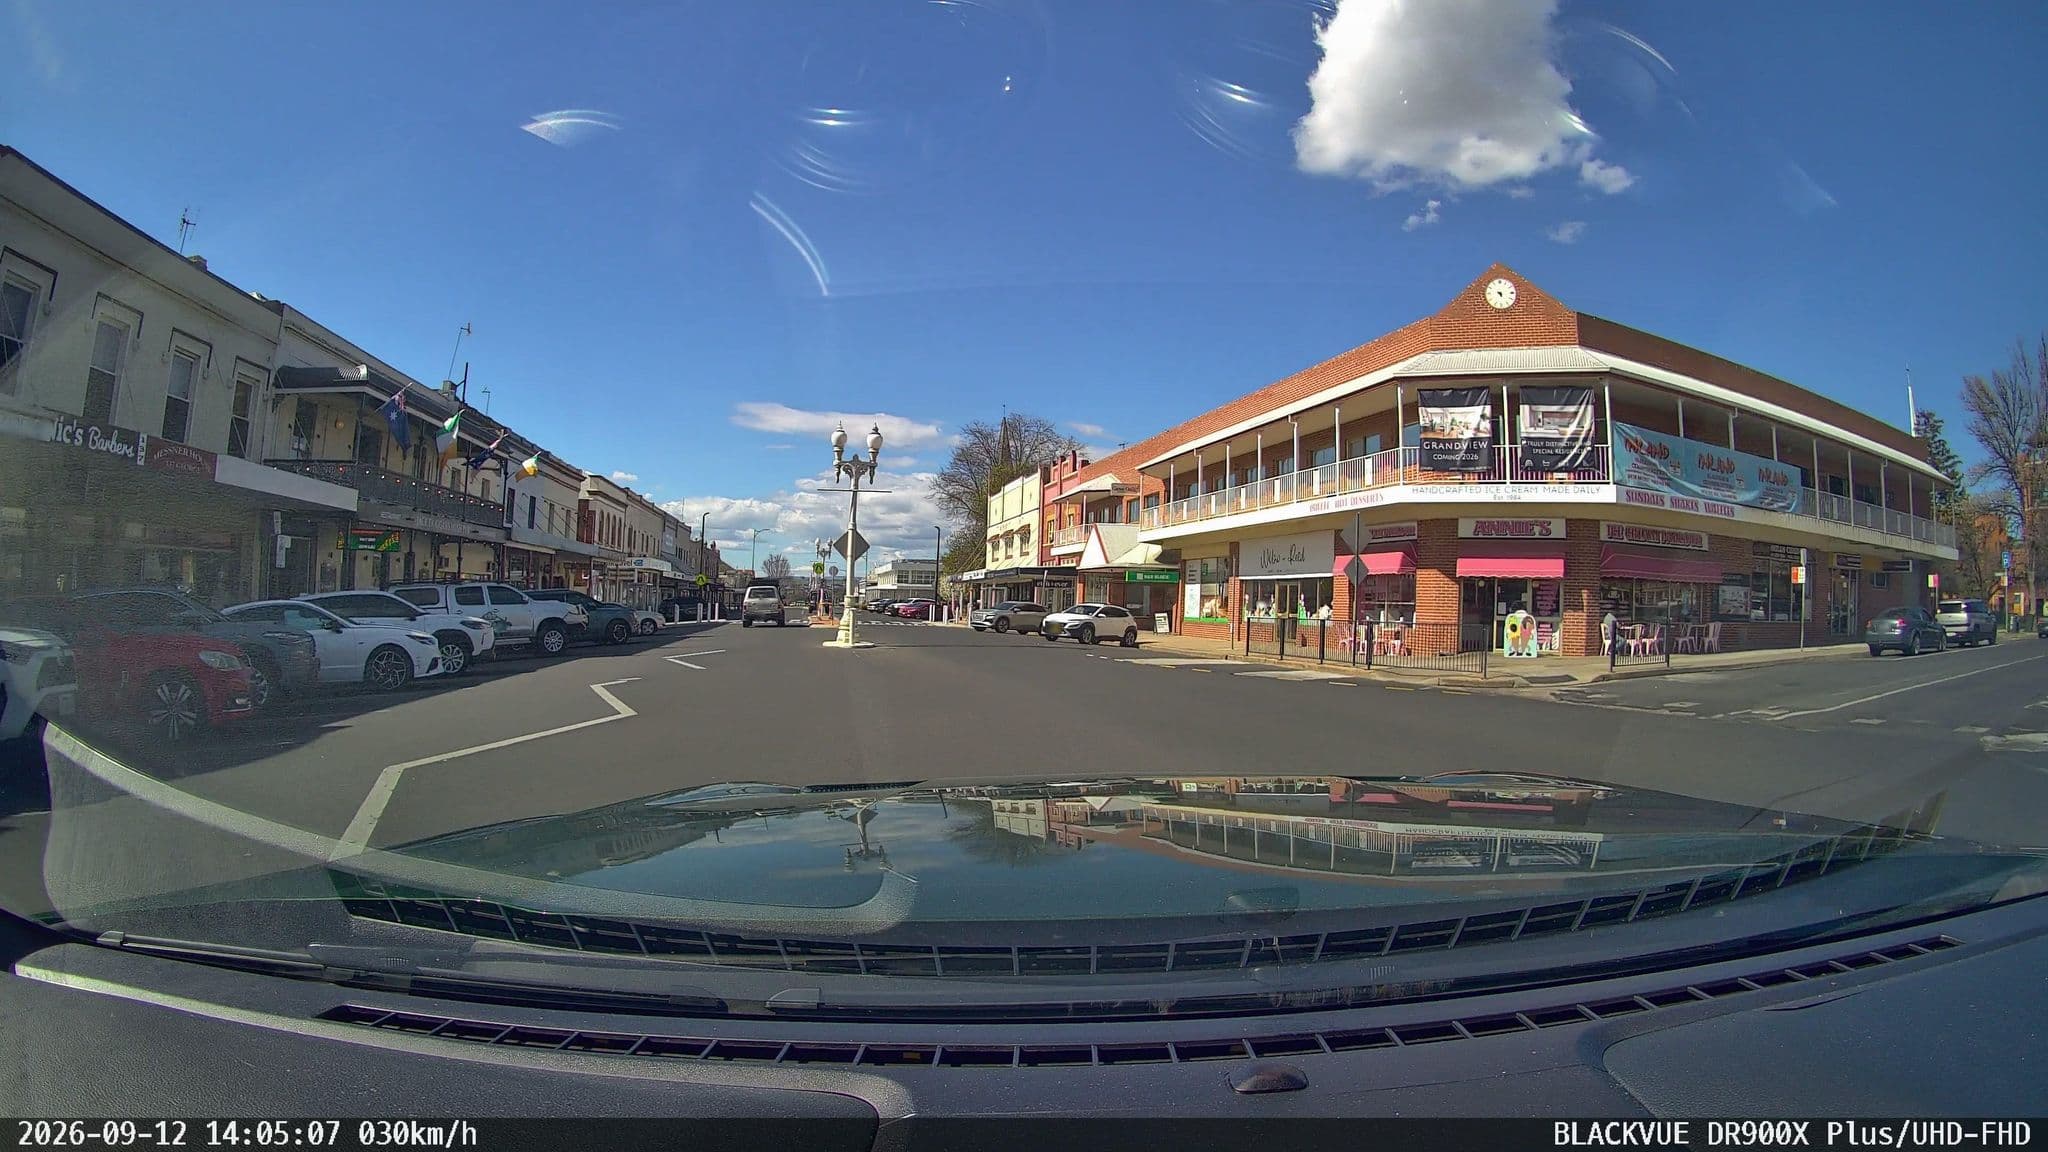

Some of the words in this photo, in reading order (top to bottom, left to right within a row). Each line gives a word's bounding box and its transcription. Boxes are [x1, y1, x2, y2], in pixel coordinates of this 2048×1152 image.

[88, 425, 135, 458] Barbers
[1423, 440, 1489, 450] GRANDVIEW
[1411, 485, 1482, 494] HANDCRAFTED
[1485, 485, 1501, 494] ICE
[1504, 485, 1538, 494] CREAM
[1542, 485, 1570, 494] MADE
[1573, 485, 1601, 494] DAILY
[1625, 489, 1665, 507] SUNDAES
[1670, 495, 1699, 512] SHAKES
[1473, 519, 1552, 537] ANNIE'S
